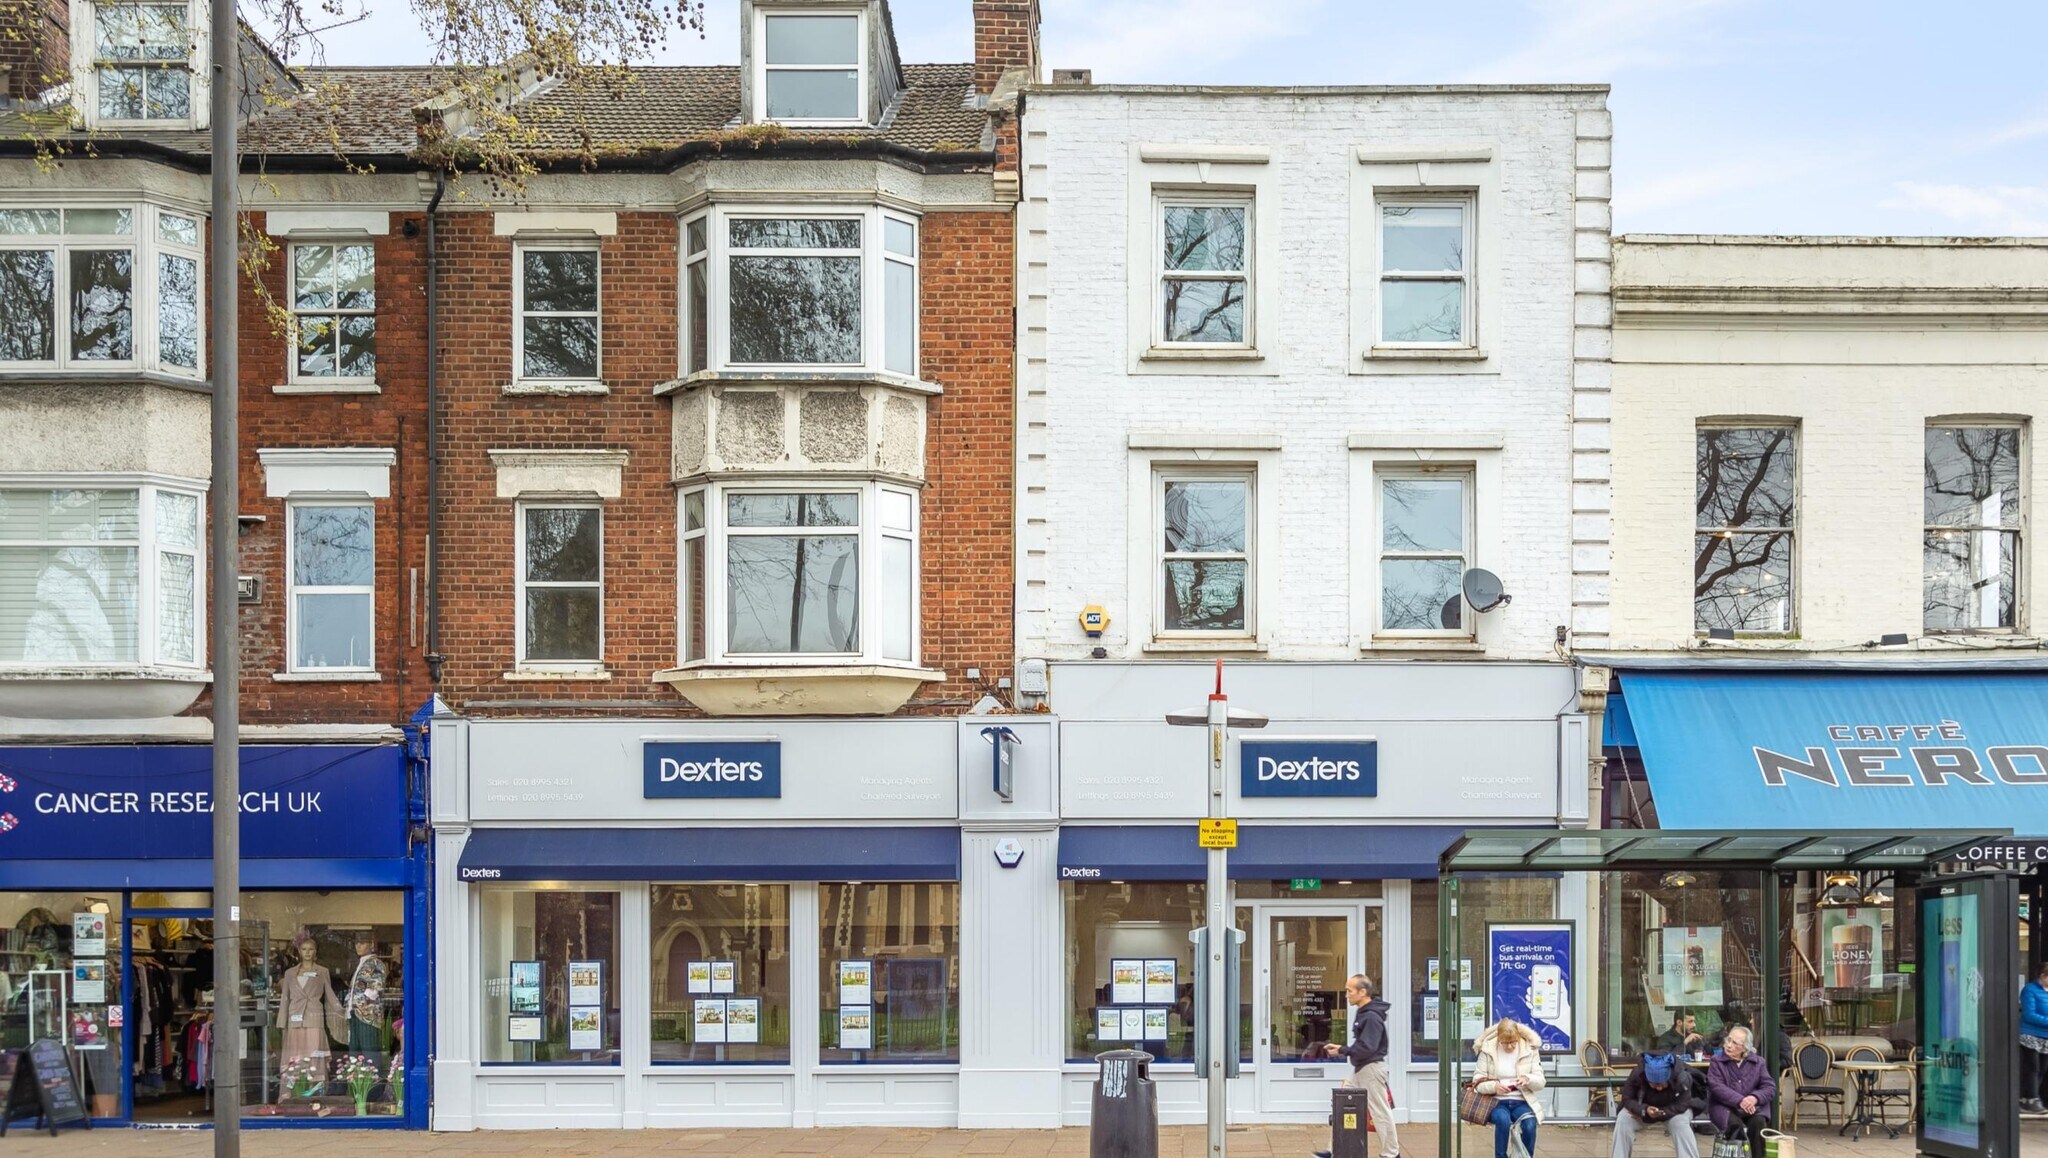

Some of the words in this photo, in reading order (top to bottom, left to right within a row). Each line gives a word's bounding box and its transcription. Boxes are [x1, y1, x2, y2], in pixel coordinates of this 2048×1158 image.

[1827, 719, 1966, 741] CAFFÈ
[660, 757, 763, 782] Dexters
[1258, 756, 1360, 781] Dexters
[1752, 745, 2048, 787] NERO
[513, 778, 529, 786] 020
[531, 778, 552, 786] 8995
[553, 778, 573, 786] 4321
[860, 776, 902, 787] Managing
[1103, 776, 1120, 785] 020
[1144, 776, 1164, 785] 4321
[522, 793, 538, 801] 020
[540, 793, 561, 801] 8995
[563, 793, 584, 801] 5439
[1113, 792, 1129, 800] 020
[1131, 792, 1152, 800] 8995
[1153, 792, 1174, 800] 5439
[35, 792, 139, 813] CANCER
[150, 791, 279, 813] RESECH
[288, 792, 322, 813] UK
[462, 867, 501, 878] Dexters
[1062, 867, 1101, 877] Dexters
[1937, 912, 1962, 936] Less
[1832, 950, 1874, 960] HONEY
